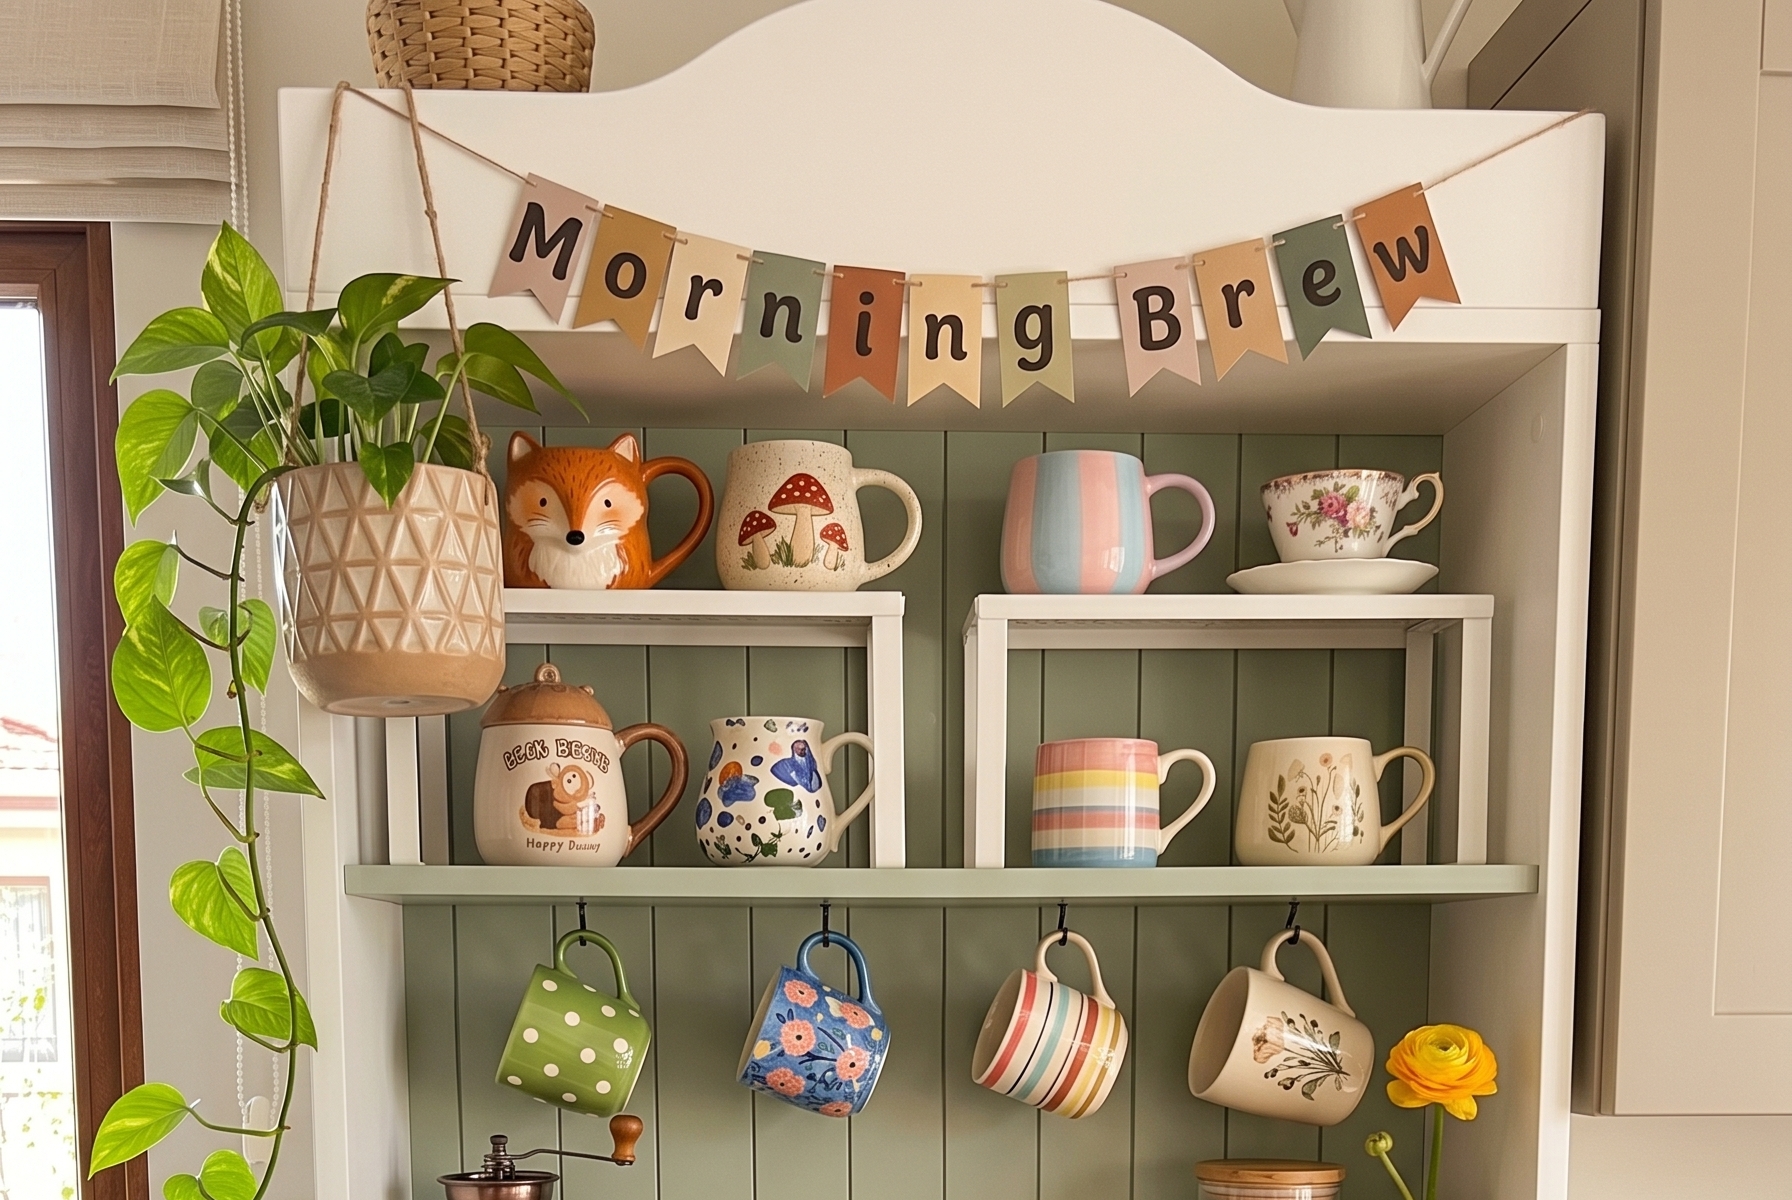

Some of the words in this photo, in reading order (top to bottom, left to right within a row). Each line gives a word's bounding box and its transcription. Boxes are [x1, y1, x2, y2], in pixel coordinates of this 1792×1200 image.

[509, 201, 1053, 372] Morning
[1132, 225, 1430, 351] Brew
[526, 837, 564, 854] Happy
